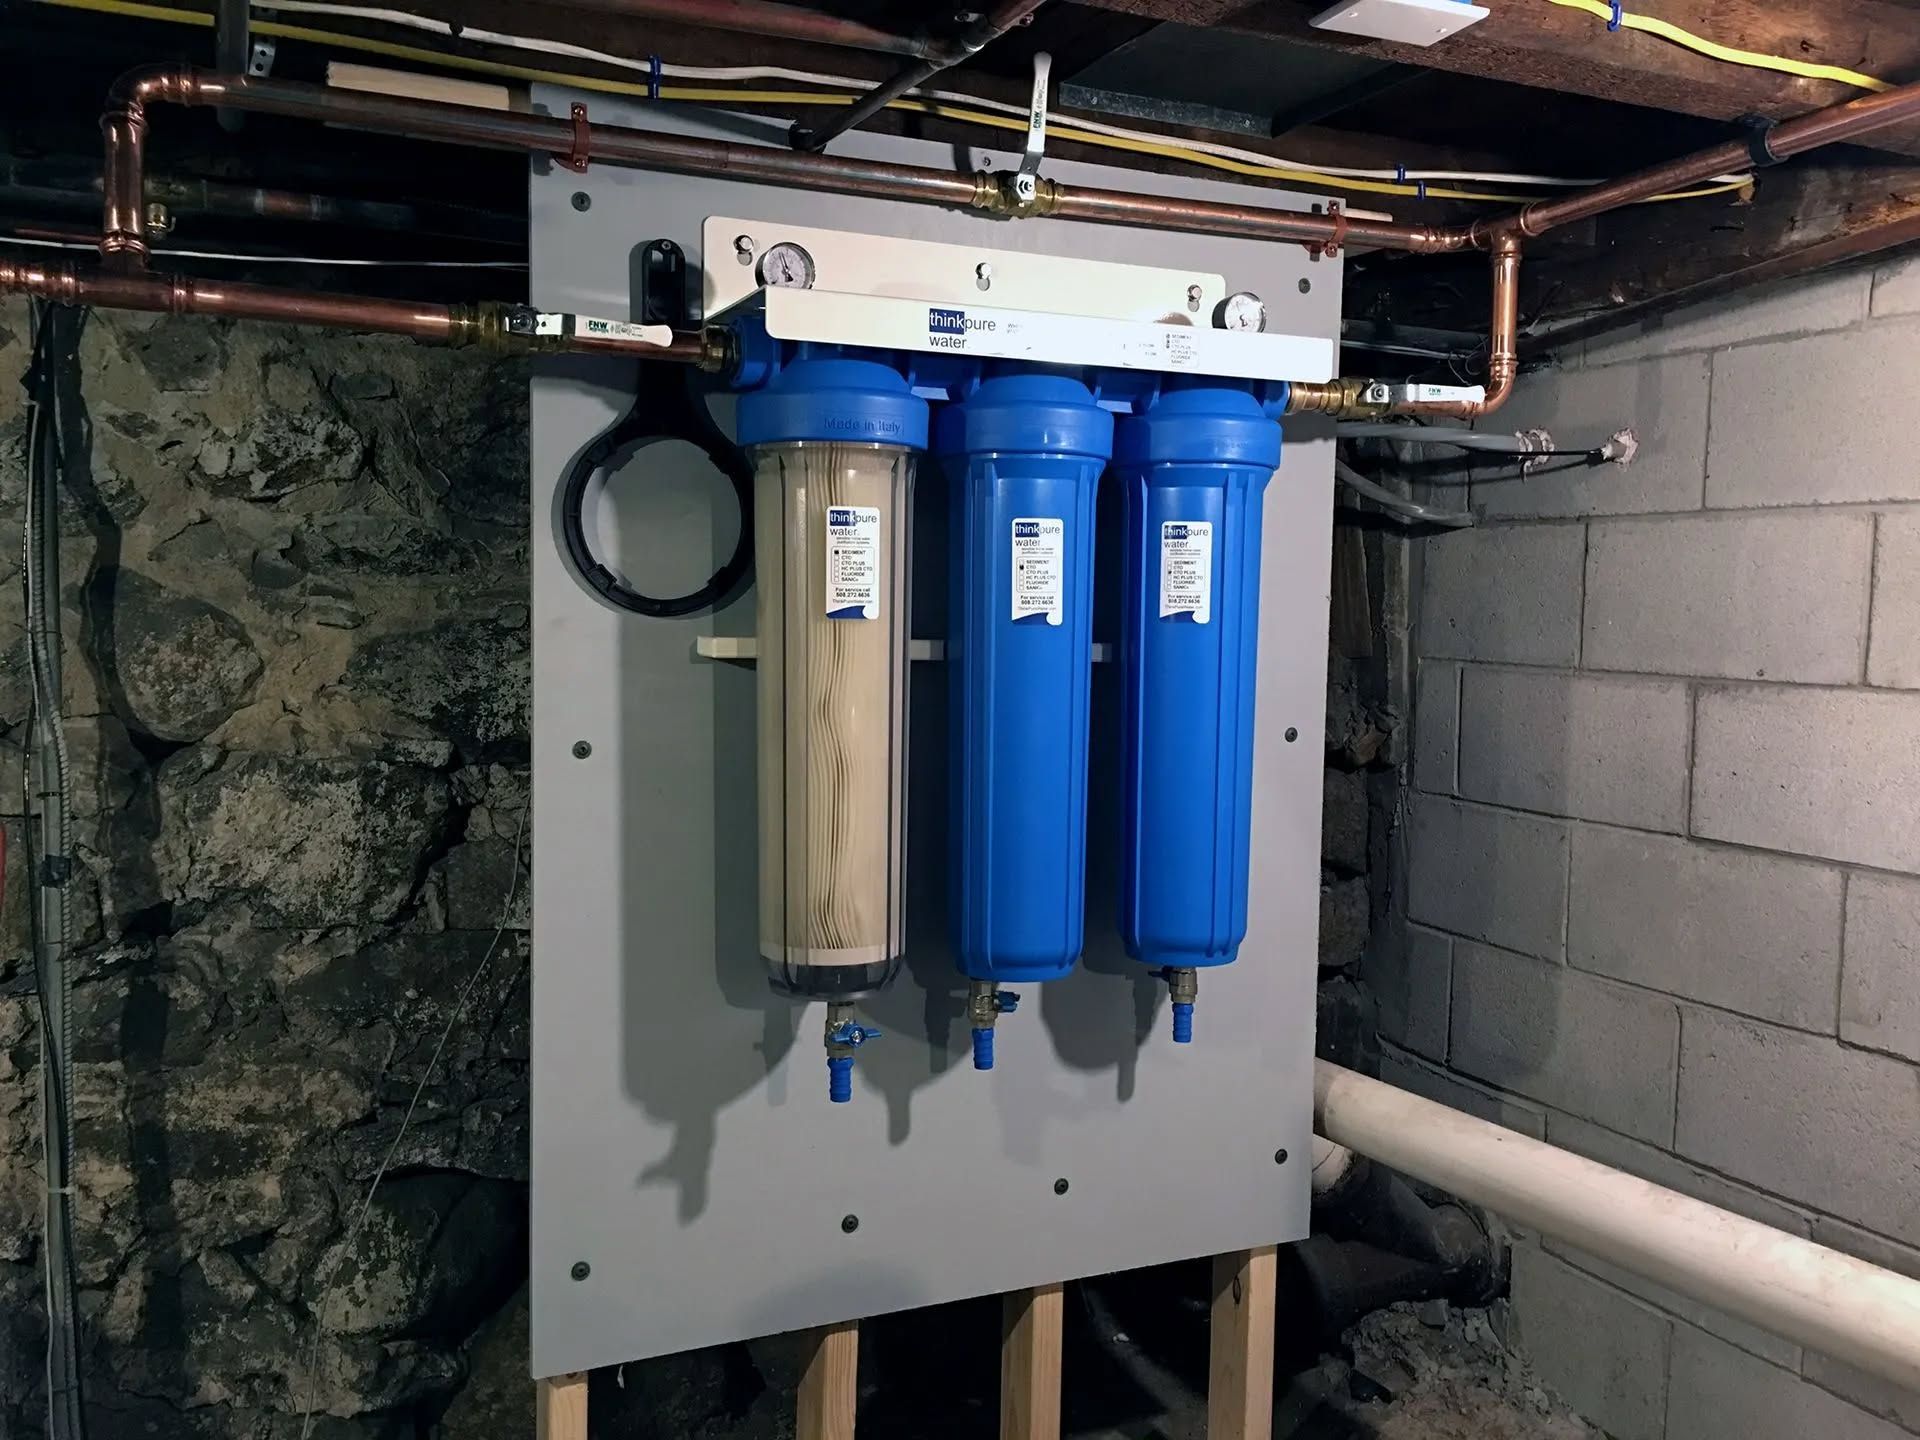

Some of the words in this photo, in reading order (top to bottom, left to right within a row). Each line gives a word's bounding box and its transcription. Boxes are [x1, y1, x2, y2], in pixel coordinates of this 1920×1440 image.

[588, 320, 608, 330] FNW
[929, 335, 967, 349] water
[824, 419, 860, 430] Made
[830, 528, 857, 536] water
